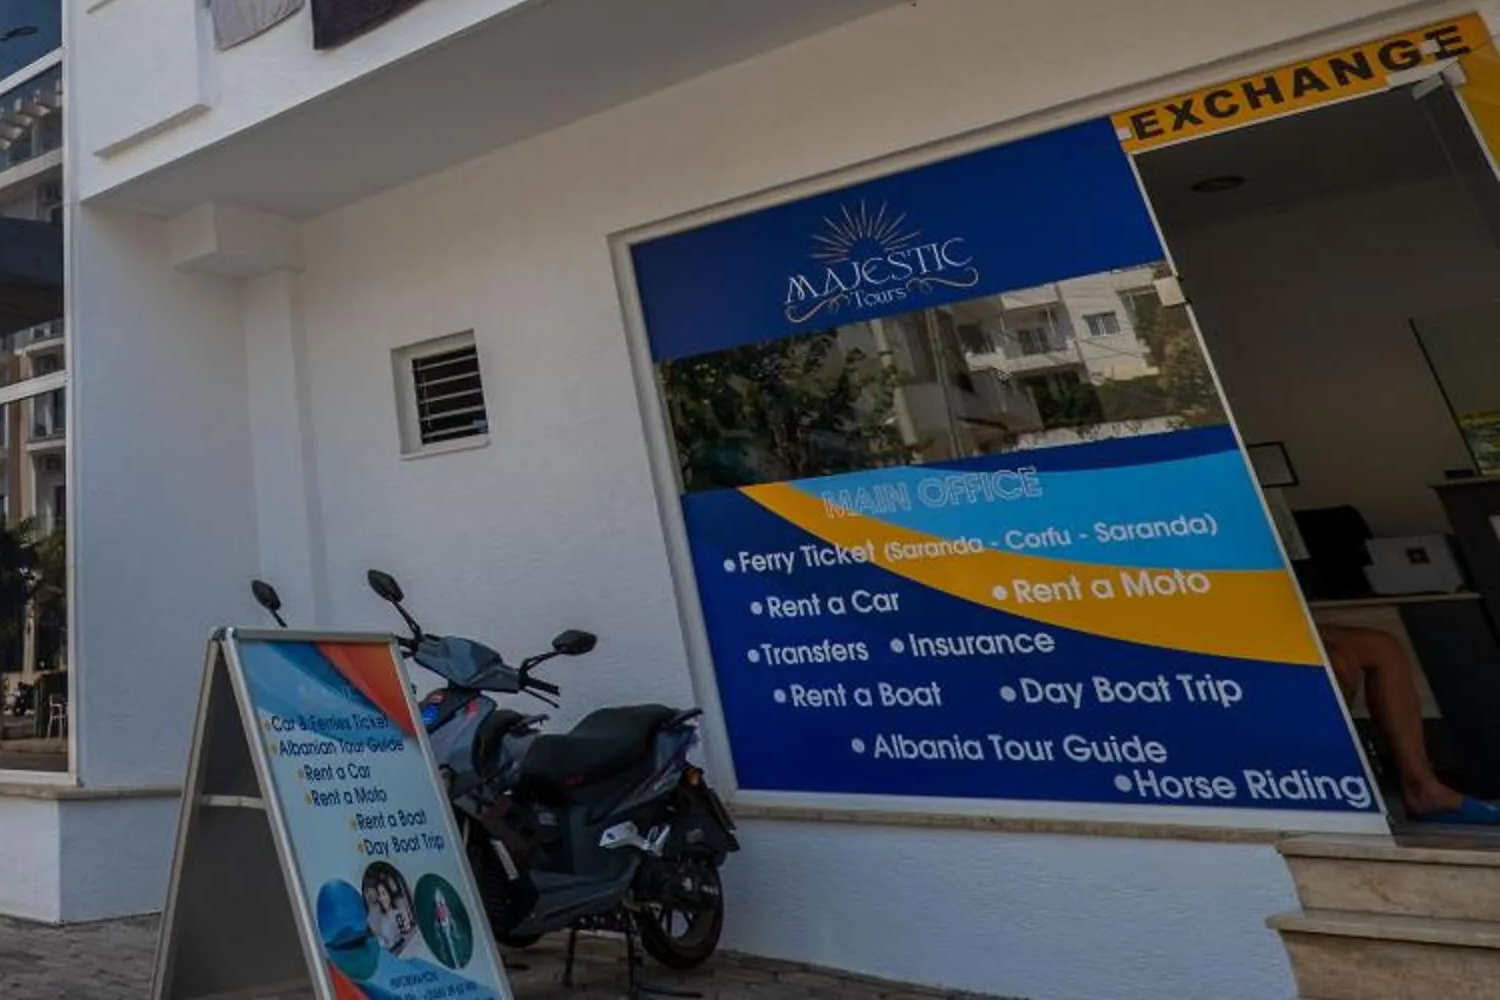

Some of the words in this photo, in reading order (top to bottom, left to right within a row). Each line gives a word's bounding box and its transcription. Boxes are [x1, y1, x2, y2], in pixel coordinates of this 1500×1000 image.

[1130, 25, 1471, 141] EXCHANGE
[783, 237, 974, 305] MAJESTIC
[849, 287, 907, 308] Tours
[820, 480, 912, 519] MAIN
[917, 466, 1043, 508] OFFICE
[738, 551, 795, 575] Ferry
[800, 539, 875, 568] Ticket
[883, 536, 983, 562] (Saranda
[1004, 527, 1072, 551] Corfu
[1093, 513, 1218, 543] Saranda)
[1011, 575, 1082, 604] Rent
[1090, 578, 1114, 599] a
[1119, 568, 1211, 598] Moto
[766, 593, 821, 618] Rent
[827, 597, 846, 616] a
[851, 590, 899, 614] Car
[760, 638, 869, 666] Transfers
[907, 632, 1055, 657] Insurance
[789, 683, 846, 707] Rent
[854, 688, 872, 707] a
[878, 681, 942, 707] Boat
[1019, 677, 1083, 709] Day
[1092, 675, 1171, 703] Boat
[1176, 674, 1243, 708] Trip
[271, 715, 297, 732] Car
[279, 739, 337, 757] Albanian
[338, 738, 364, 753] Tour
[366, 736, 405, 752] Guide
[873, 733, 984, 760] Albania
[988, 734, 1055, 761] Tour
[1062, 734, 1168, 763] Guide
[303, 764, 334, 782] Rent
[336, 766, 346, 780] a
[347, 763, 371, 780] Car
[311, 789, 341, 807] Rent
[343, 792, 353, 805] a
[354, 787, 387, 803] Moto
[1133, 769, 1236, 799] Horse
[1243, 769, 1371, 808] Riding
[356, 813, 386, 830] Rent
[387, 815, 397, 827] a
[399, 810, 427, 826] Boat
[363, 838, 389, 857] Day
[391, 835, 420, 853] Boat
[421, 832, 445, 852] Trip
